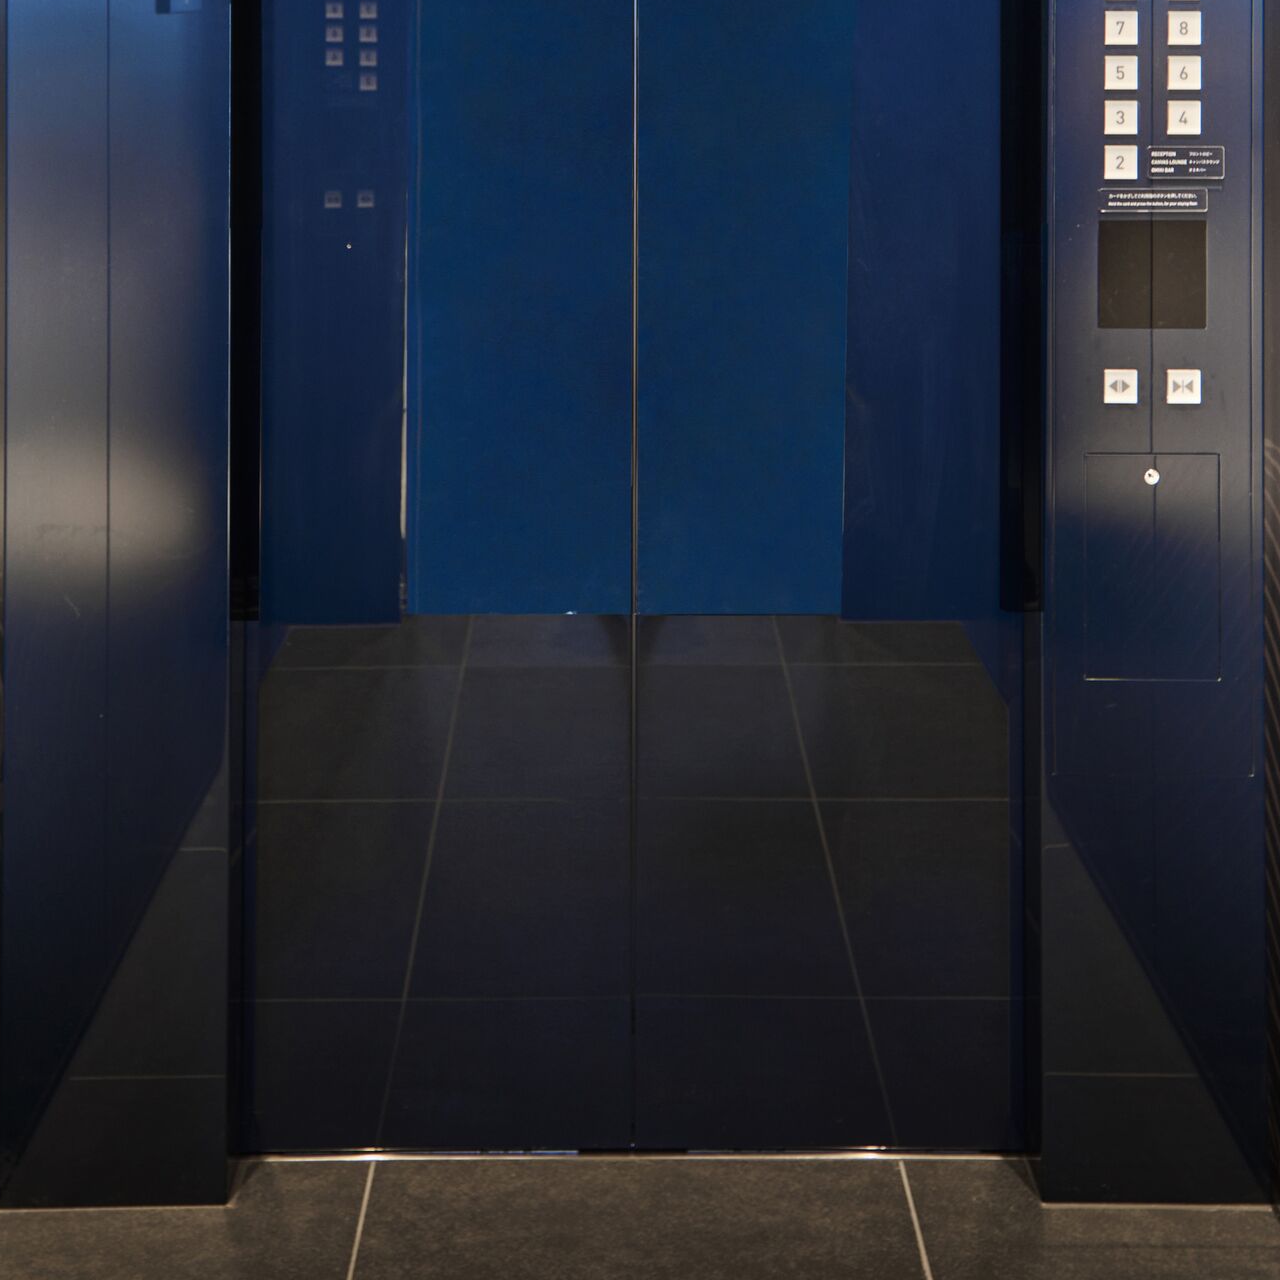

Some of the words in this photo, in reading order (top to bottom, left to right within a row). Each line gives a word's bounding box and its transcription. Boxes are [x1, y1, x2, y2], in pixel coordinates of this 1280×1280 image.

[1116, 21, 1125, 35] 7
[1179, 21, 1188, 35] 8
[1116, 65, 1125, 80] 5
[1179, 66, 1188, 80] 6
[1116, 111, 1125, 125] 3
[1179, 110, 1188, 125] 4
[1116, 156, 1125, 170] 2
